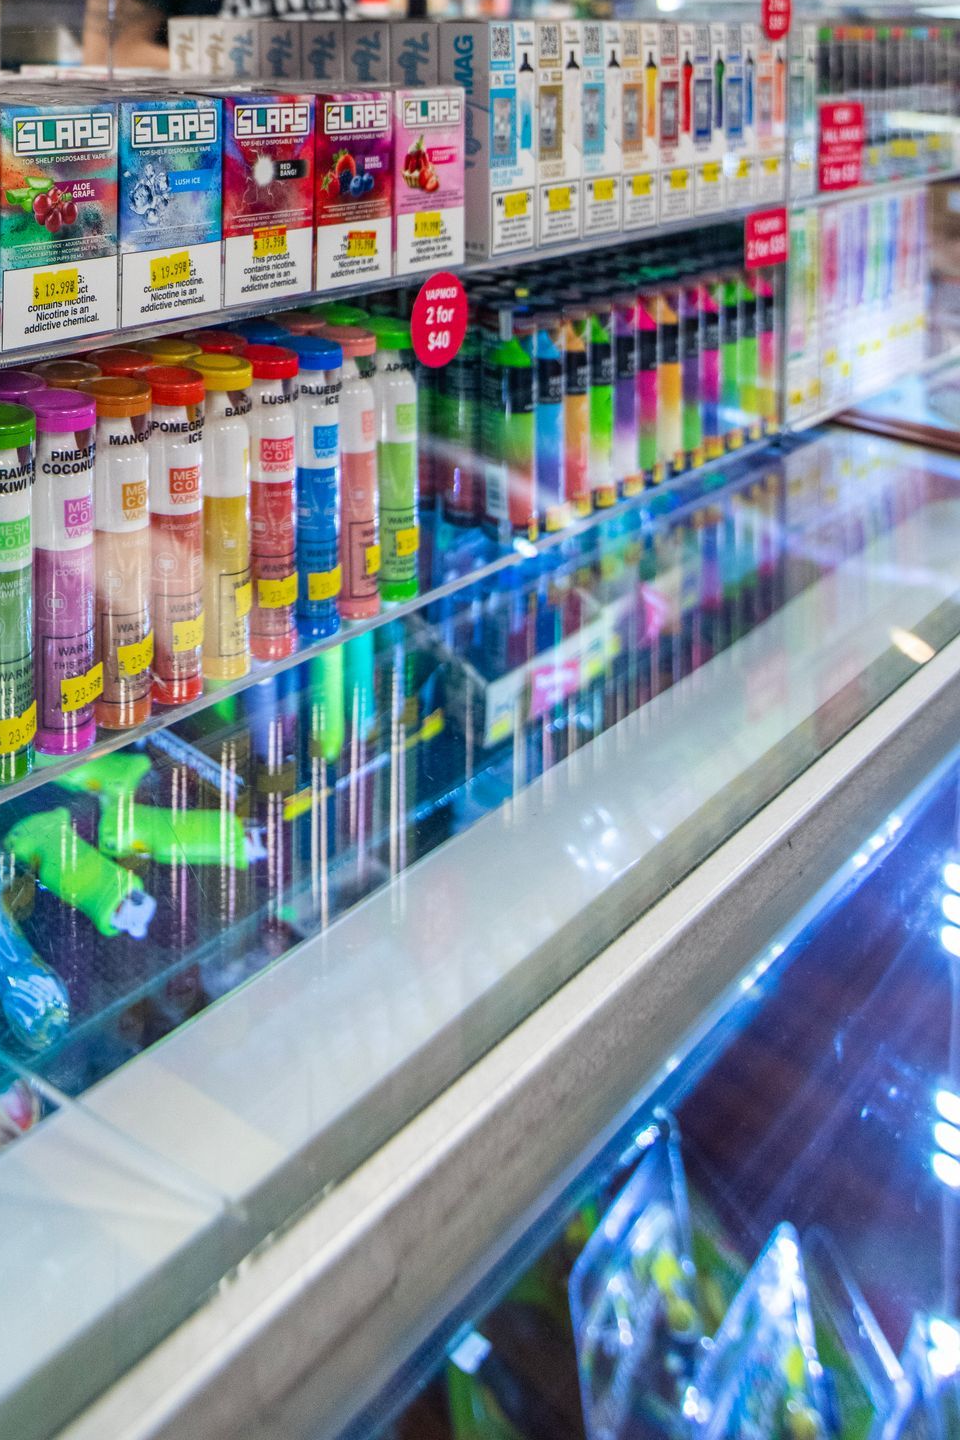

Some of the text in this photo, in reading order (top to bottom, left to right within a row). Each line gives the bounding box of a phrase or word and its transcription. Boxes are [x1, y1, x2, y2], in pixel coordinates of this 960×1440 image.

[237, 105, 308, 134] SLAPS
[328, 103, 386, 131] SLAPS
[17, 115, 110, 152] SLAPS
[135, 111, 216, 146] SLAPS
[175, 177, 201, 186] LUSH ICE
[279, 168, 297, 177] BANG!
[73, 182, 91, 192] ALOE
[73, 189, 96, 199] GRAPE
[425, 286, 457, 301] VAPMOD
[24, 313, 99, 335] addictive chemical.
[425, 306, 455, 325] 2 for
[428, 331, 450, 351] $40
[188, 430, 203, 444] ICE
